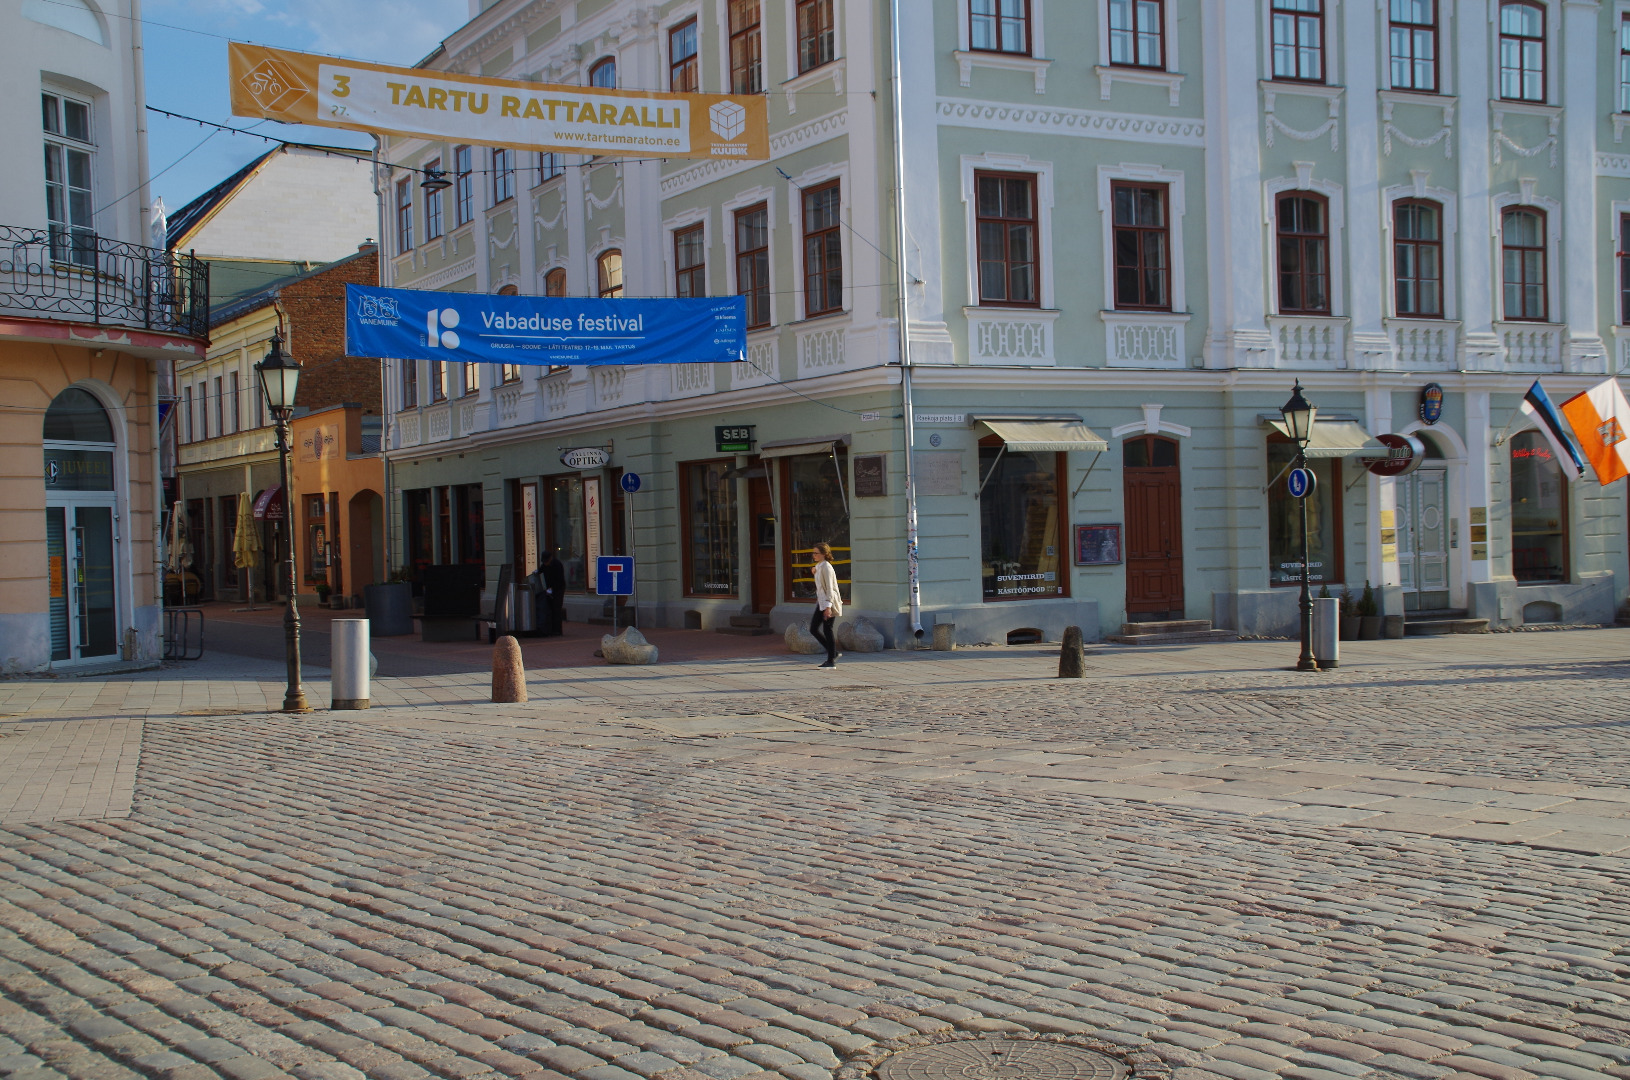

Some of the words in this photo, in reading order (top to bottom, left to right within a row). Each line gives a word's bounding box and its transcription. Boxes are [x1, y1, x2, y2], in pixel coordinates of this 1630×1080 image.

[386, 82, 489, 115] TARTU
[500, 95, 681, 129] RATTARALLI
[554, 131, 681, 146] www.tartumaraton.ee
[710, 147, 748, 155] KUUBIK
[359, 318, 399, 327] VANEMUINE
[480, 311, 573, 331] Vabaduse
[577, 313, 643, 332] festival
[916, 414, 939, 422] Raekoja
[722, 428, 749, 440] SEB
[569, 457, 604, 466] OPTIKA
[62, 460, 109, 475] JUVEEL
[997, 573, 1045, 582] SUVENIIRID
